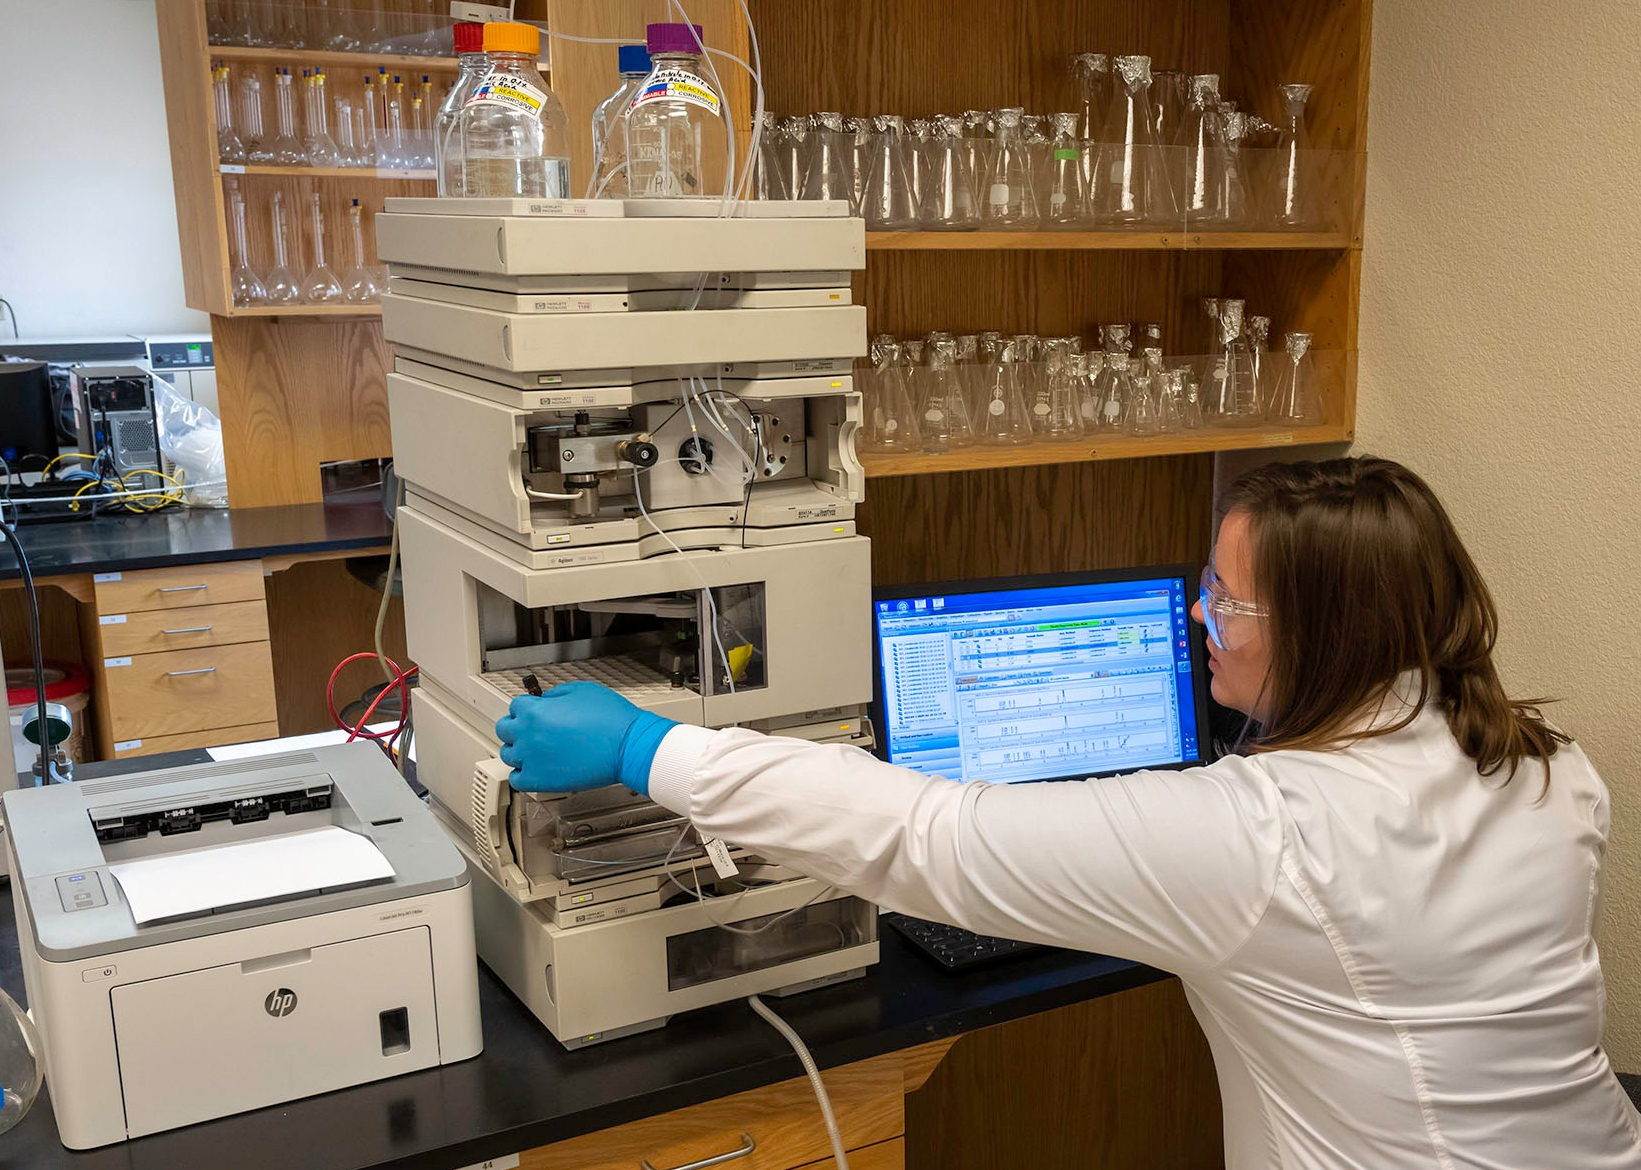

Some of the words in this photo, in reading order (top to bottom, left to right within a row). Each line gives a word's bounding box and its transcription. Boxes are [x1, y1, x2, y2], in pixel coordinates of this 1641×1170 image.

[498, 88, 530, 101] REACTIVE
[678, 84, 710, 98] REACTIVE
[678, 91, 714, 108] CORROSIVE
[496, 94, 534, 111] CORROSIVE
[268, 987, 295, 1018] hp
